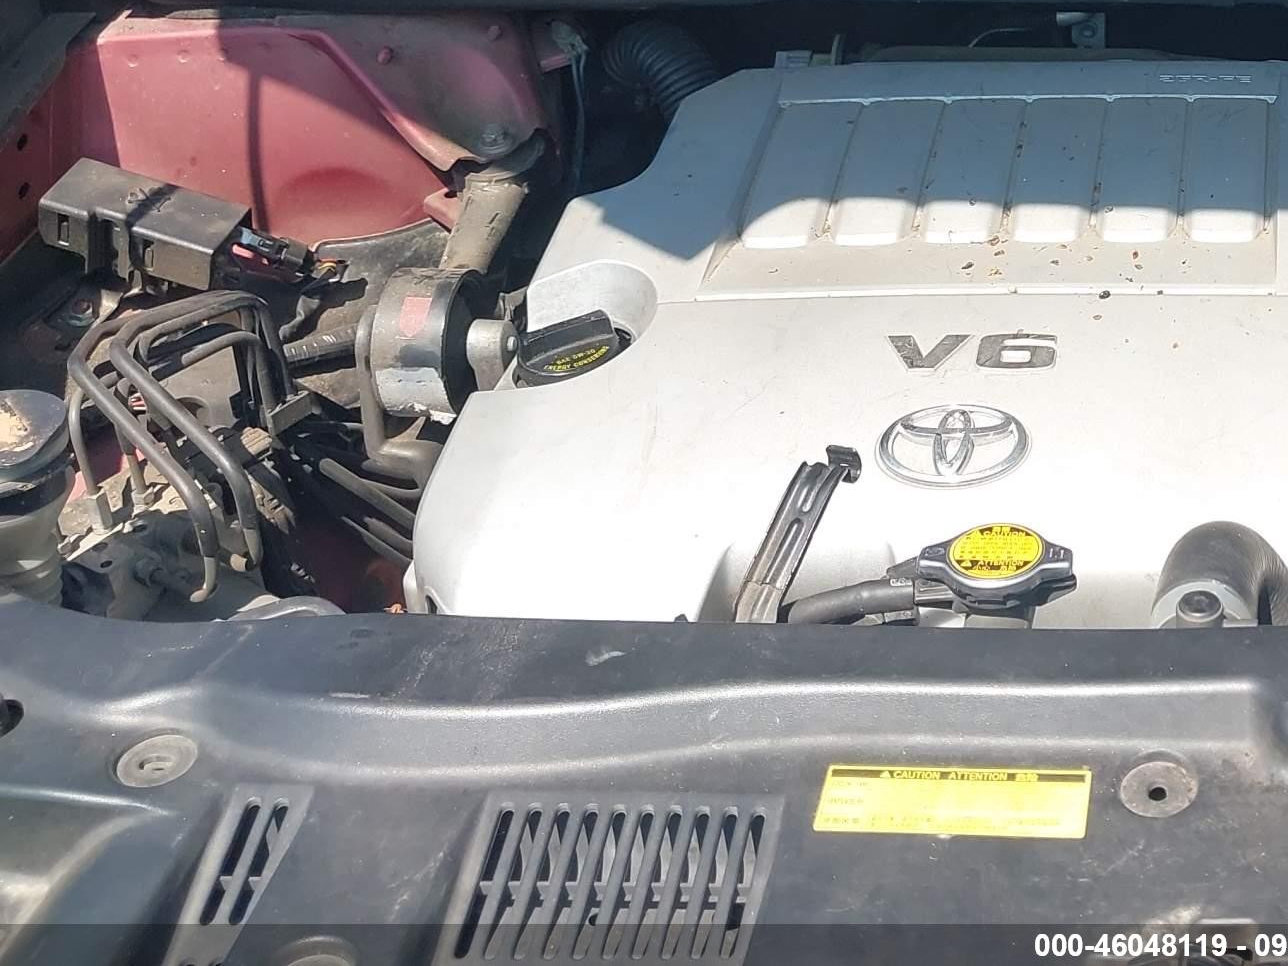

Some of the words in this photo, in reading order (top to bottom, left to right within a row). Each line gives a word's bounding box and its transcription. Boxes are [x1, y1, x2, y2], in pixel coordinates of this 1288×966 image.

[888, 333, 1058, 369] V6
[893, 770, 941, 780] CAUTION
[948, 771, 1008, 781] ATTENTION
